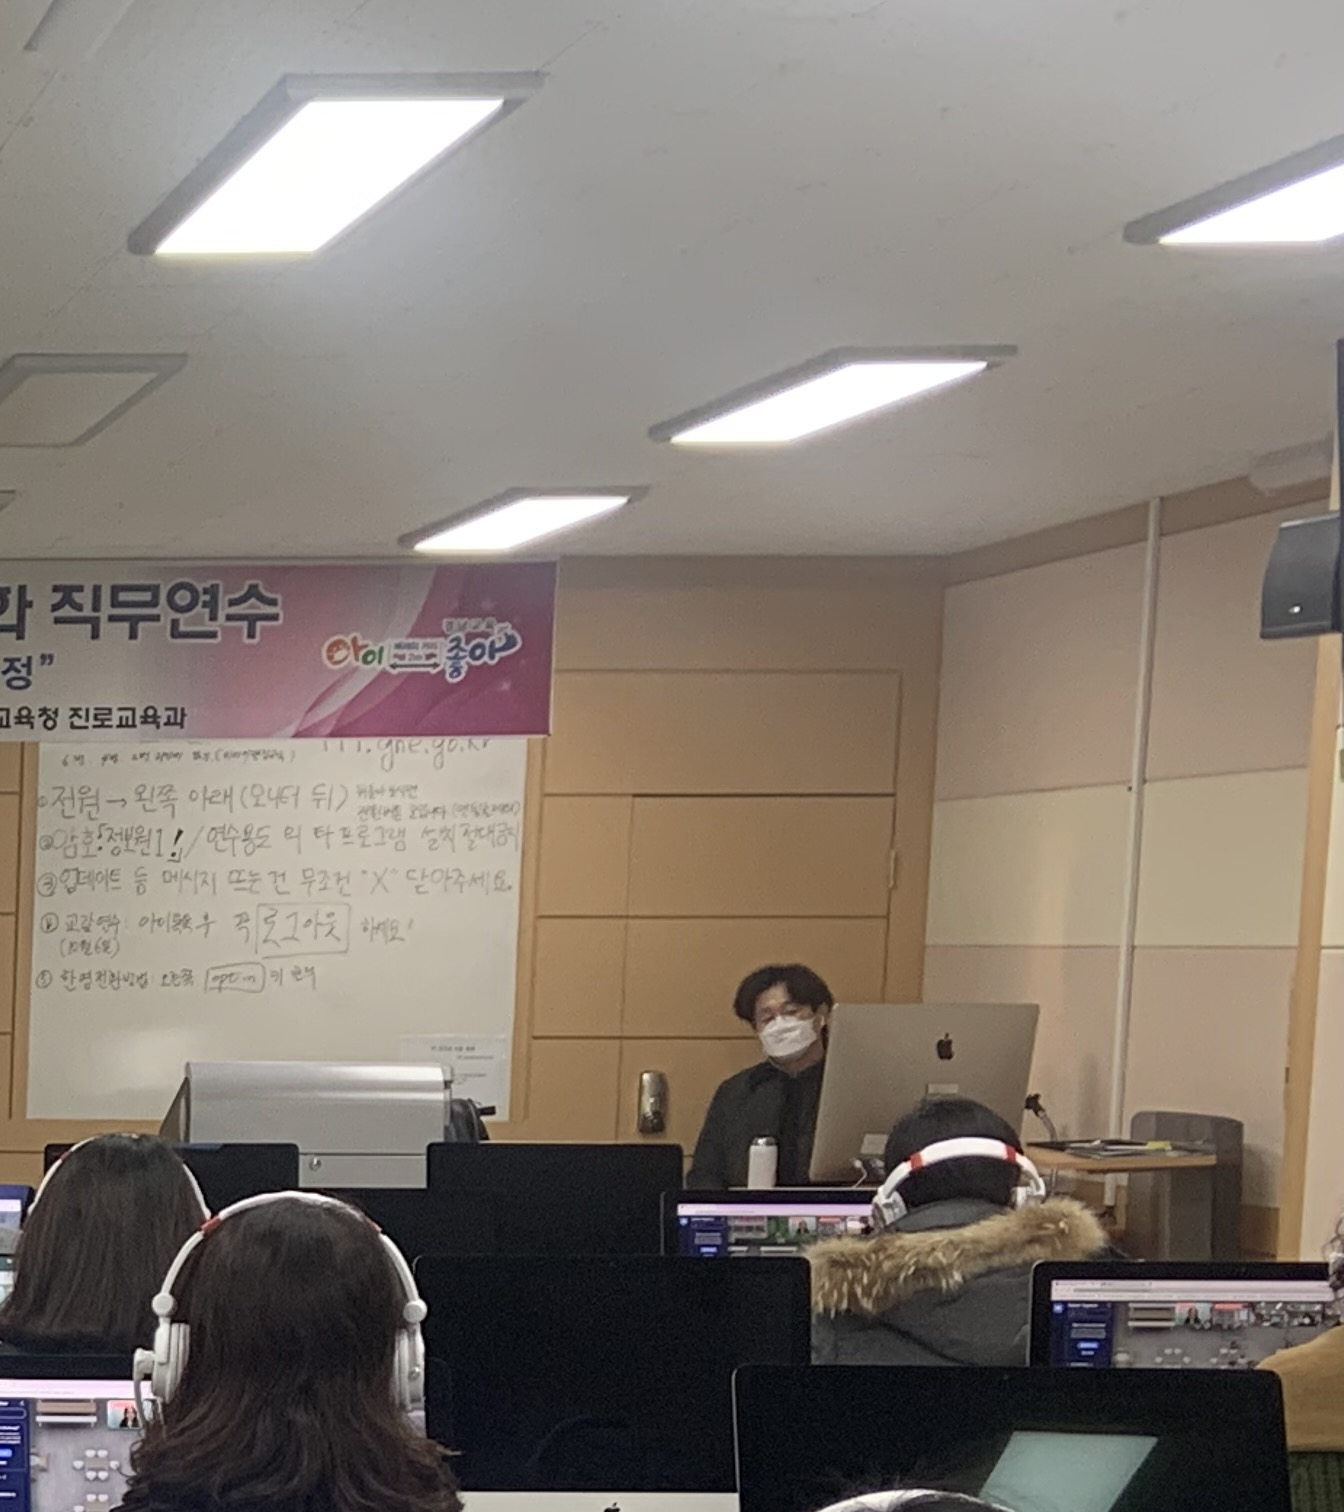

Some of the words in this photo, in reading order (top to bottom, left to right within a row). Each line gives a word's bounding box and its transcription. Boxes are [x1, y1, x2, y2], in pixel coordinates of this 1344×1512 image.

[50, 579, 281, 641] 직무연수
[68, 706, 187, 731] 진로교육과
[134, 783, 179, 820] 왼쪽
[188, 784, 234, 814] 아래
